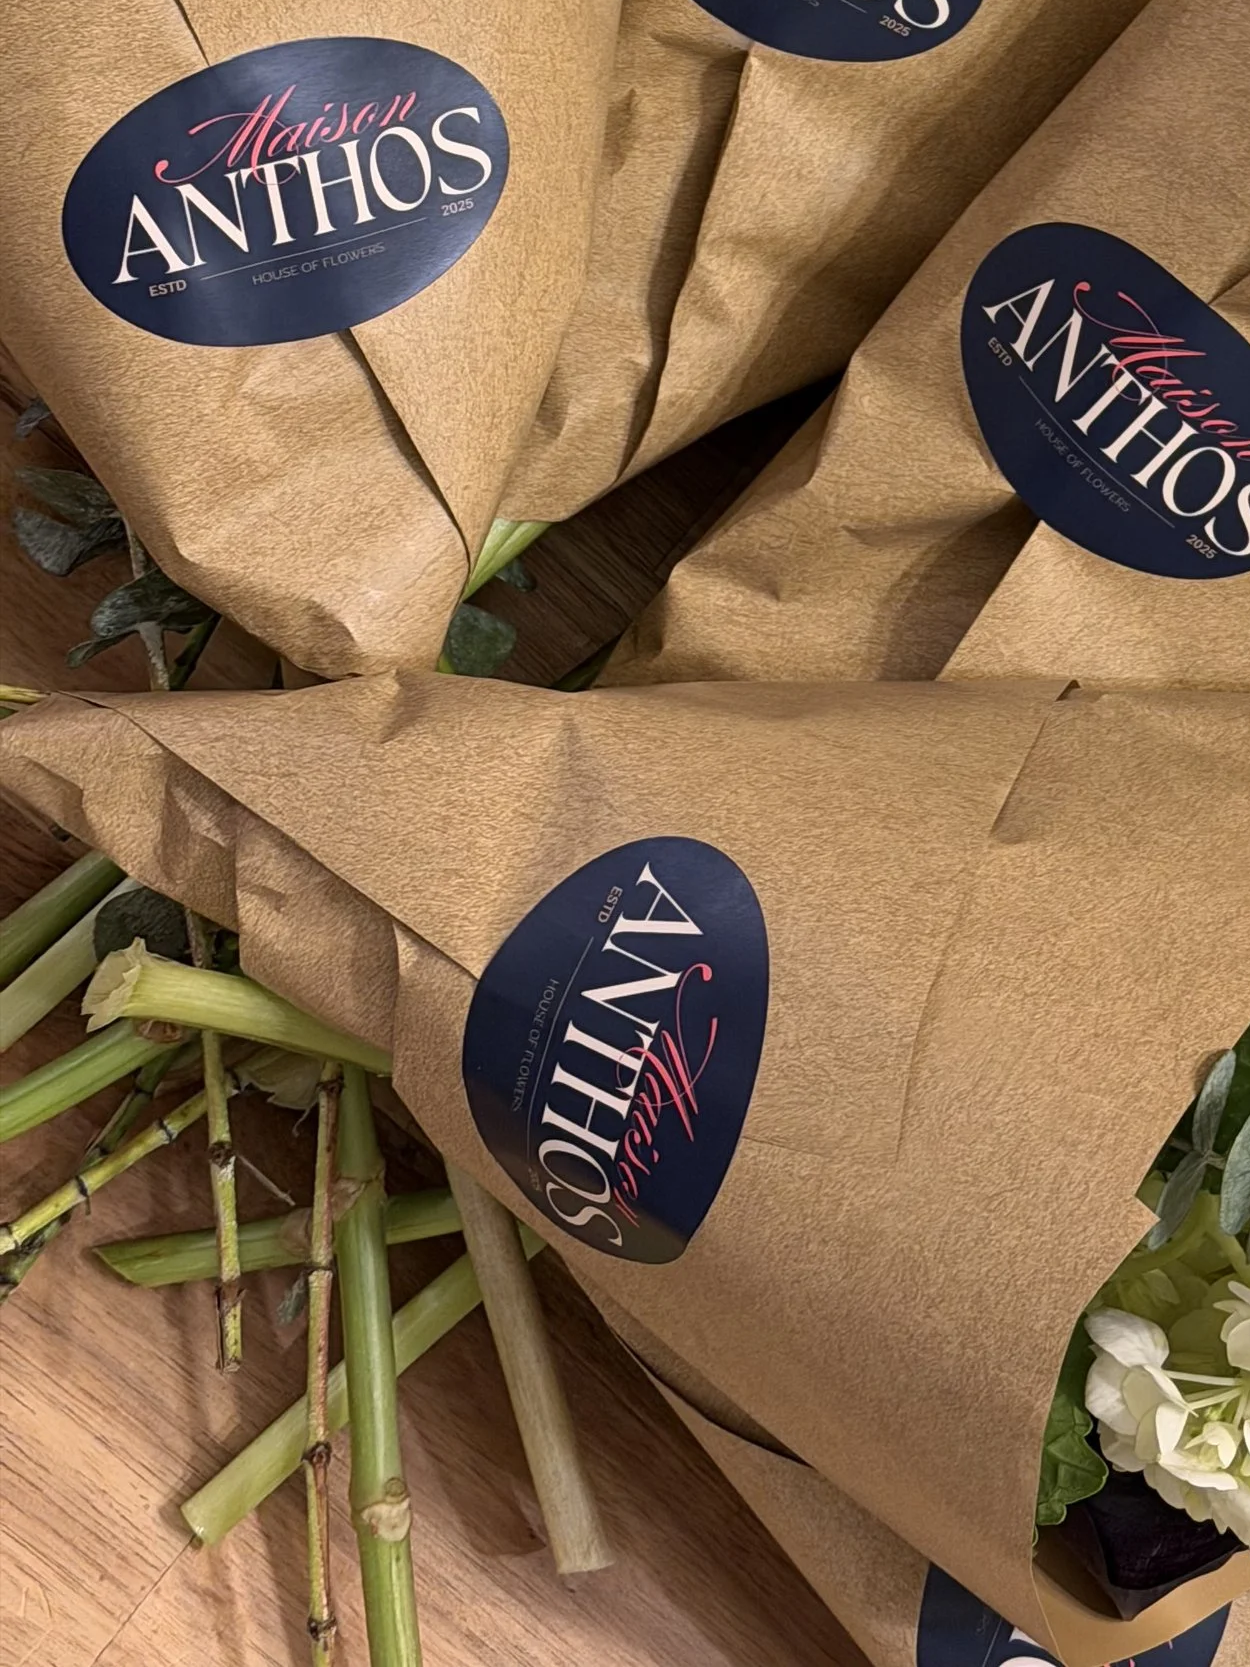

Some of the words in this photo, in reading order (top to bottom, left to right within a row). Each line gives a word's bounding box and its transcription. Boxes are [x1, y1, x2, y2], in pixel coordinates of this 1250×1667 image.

[878, 15, 912, 38] 2025
[153, 83, 422, 186] Maison
[110, 106, 493, 285] ANTHOS
[148, 279, 187, 298] ESTD
[440, 197, 475, 217] 2025
[252, 264, 300, 286] HOUSE
[301, 260, 320, 273] OF
[322, 241, 387, 269] FLOWERS
[987, 336, 1014, 368] ESTD
[1185, 534, 1219, 560] 2025
[1034, 418, 1070, 456] HOUSE
[1080, 467, 1132, 513] FLOWERS
[598, 885, 624, 924] ESTD
[532, 978, 560, 1029] HOUSE
[537, 861, 705, 1247] ANTHOS
